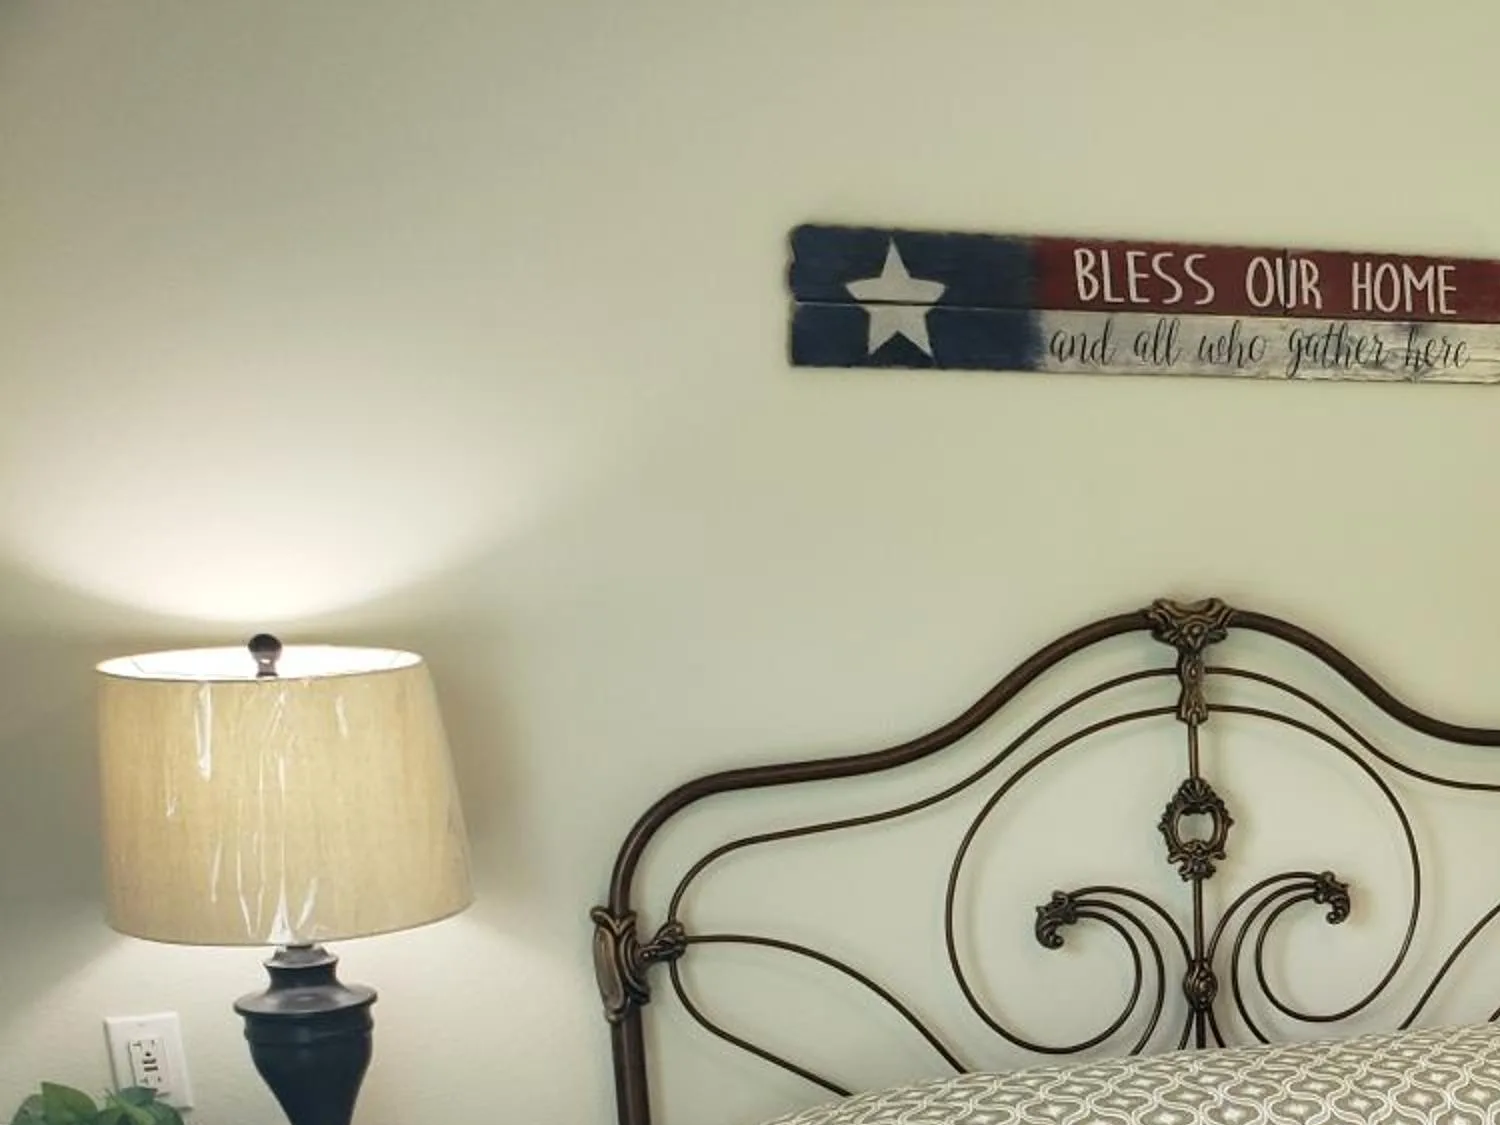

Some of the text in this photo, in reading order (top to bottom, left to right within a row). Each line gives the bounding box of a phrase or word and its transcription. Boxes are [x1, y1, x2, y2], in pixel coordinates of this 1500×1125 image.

[1073, 248, 1457, 315] BLESS OUR HOME
[1050, 317, 1471, 379] and all who gather here
